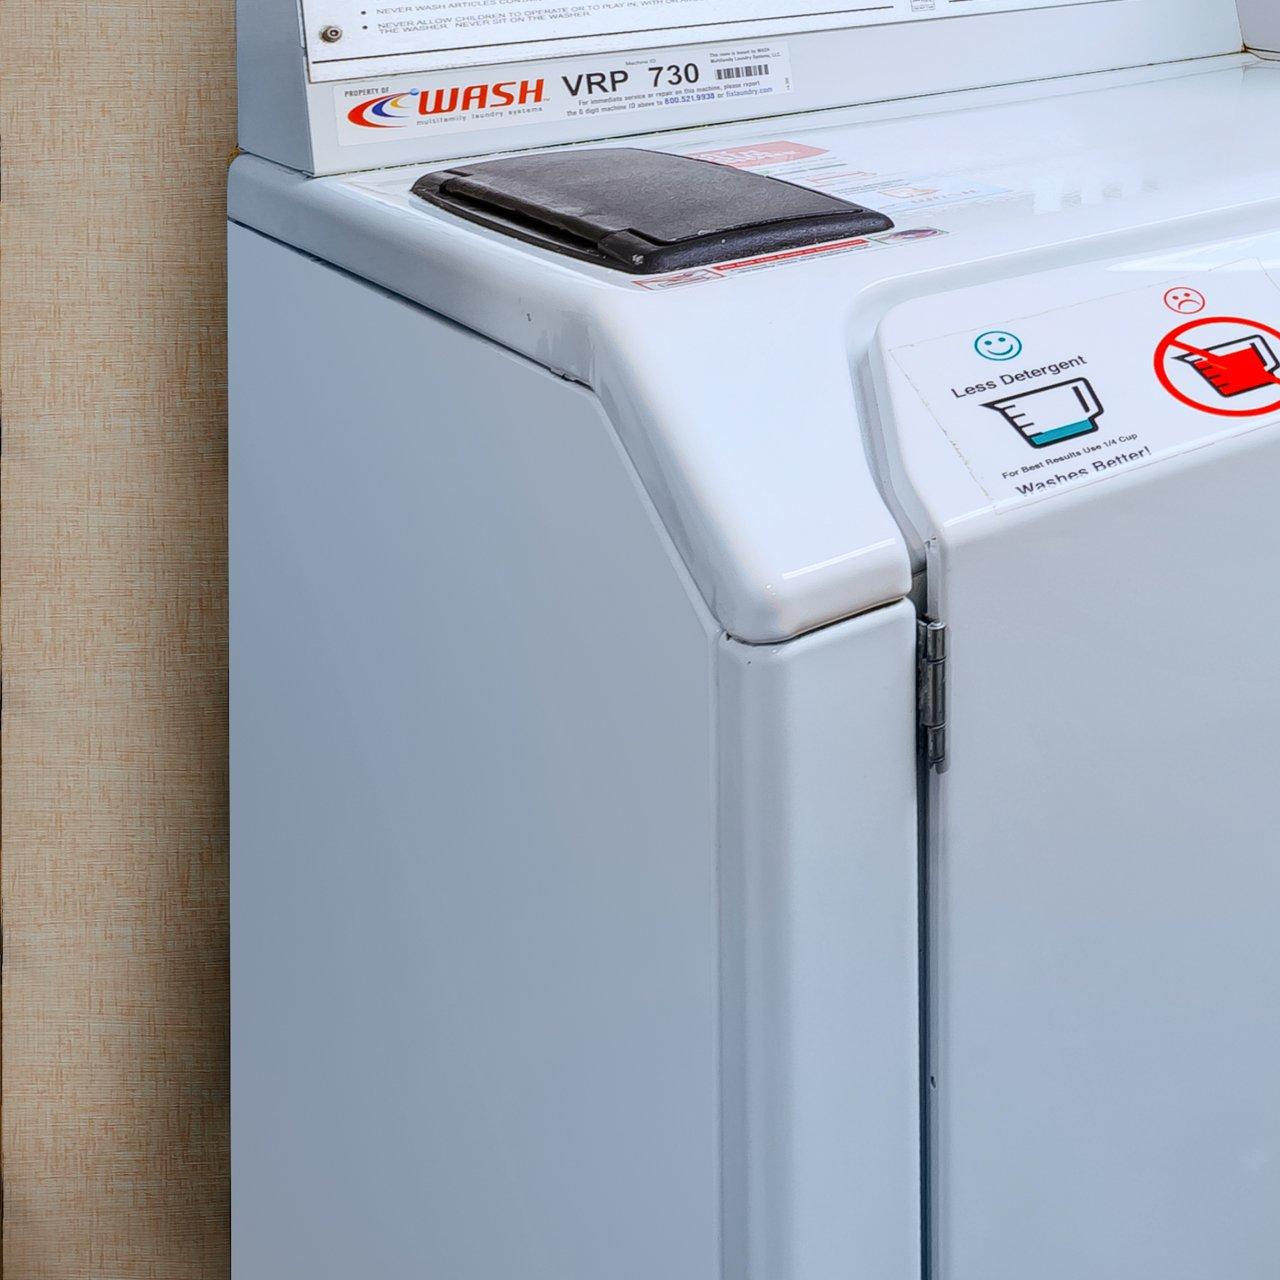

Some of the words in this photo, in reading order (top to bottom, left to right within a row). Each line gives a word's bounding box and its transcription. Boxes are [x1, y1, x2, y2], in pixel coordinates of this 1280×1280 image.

[344, 87, 376, 97] PROPERTY
[416, 78, 546, 115] WASH
[561, 69, 629, 97] VRP
[648, 62, 700, 88] 730
[416, 114, 467, 126] multifamily
[471, 110, 505, 120] laundry
[508, 106, 543, 116] systems
[951, 379, 997, 399] Less
[1000, 355, 1088, 386] Detergent
[1002, 469, 1019, 480] For
[1020, 461, 1044, 473] Best
[1046, 450, 1082, 465] Results
[1083, 444, 1102, 454] Use
[1104, 438, 1117, 448] 1/4
[1118, 432, 1138, 444] Cup
[1015, 468, 1090, 495] Washes
[1092, 445, 1152, 473] Better!
